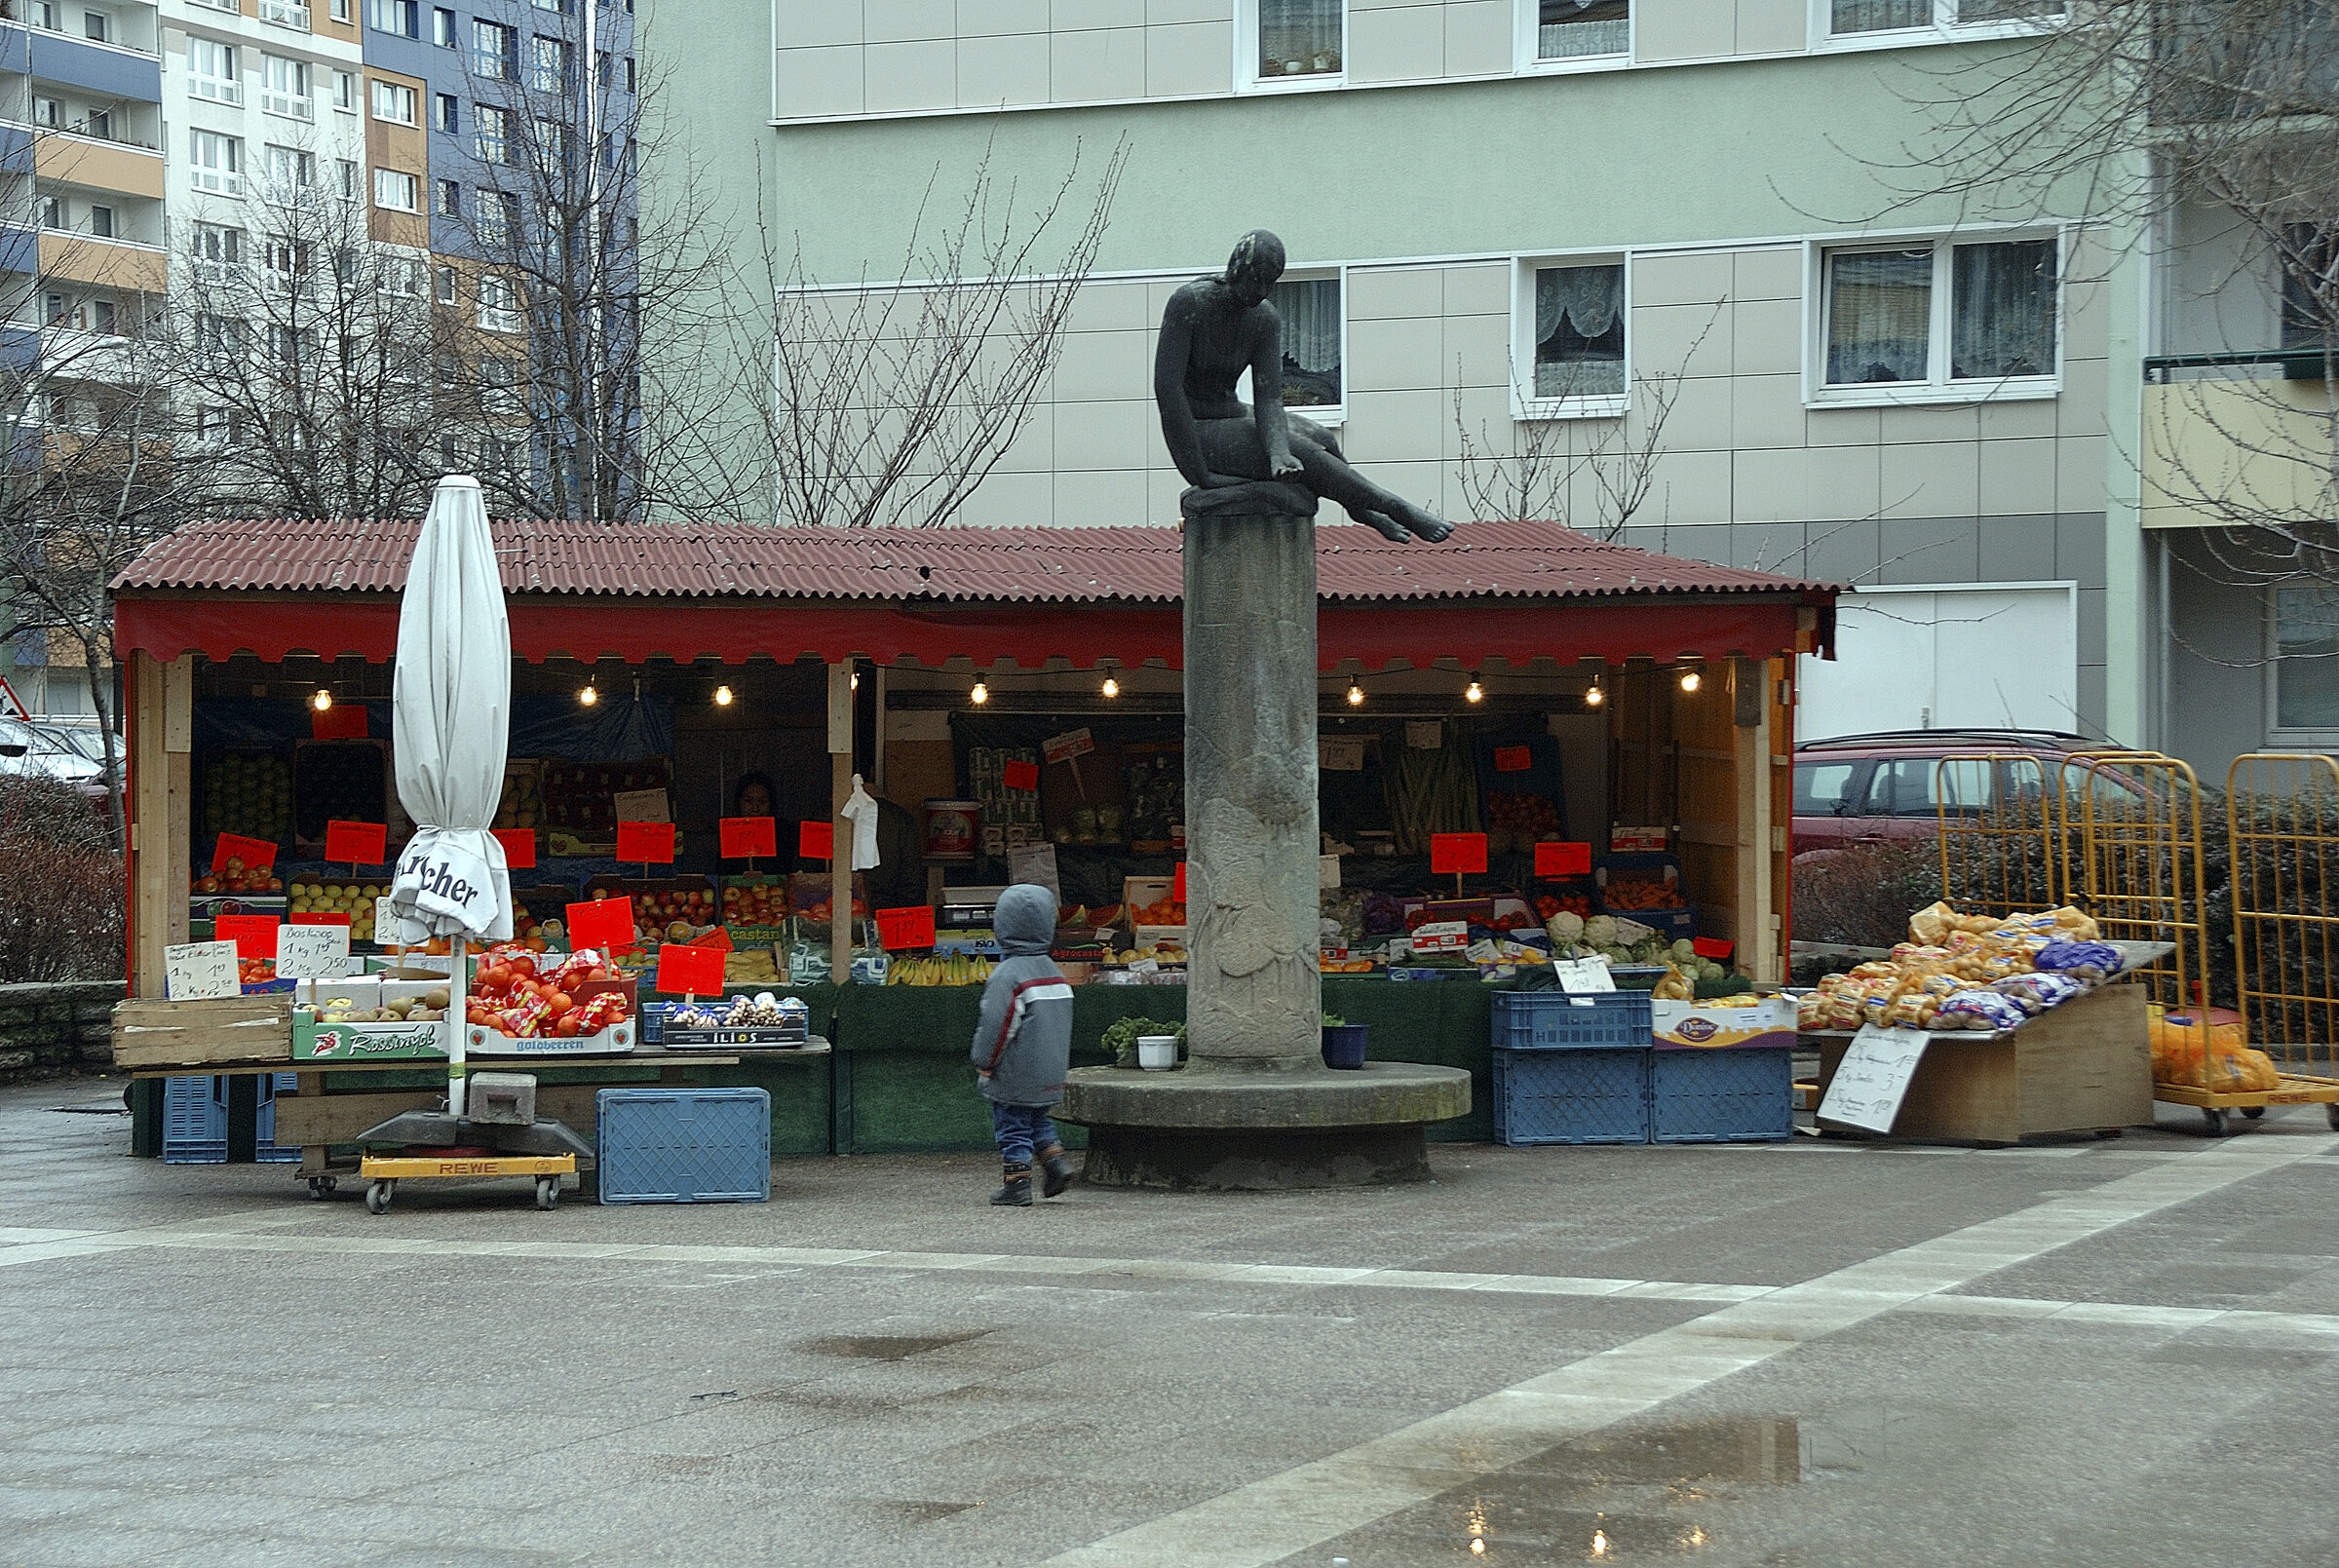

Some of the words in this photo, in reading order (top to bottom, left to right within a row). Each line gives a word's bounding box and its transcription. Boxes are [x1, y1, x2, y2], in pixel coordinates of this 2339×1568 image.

[281, 958, 294, 975] 2
[2267, 1093, 2310, 1103] REWE
[440, 1162, 498, 1174] REWE
